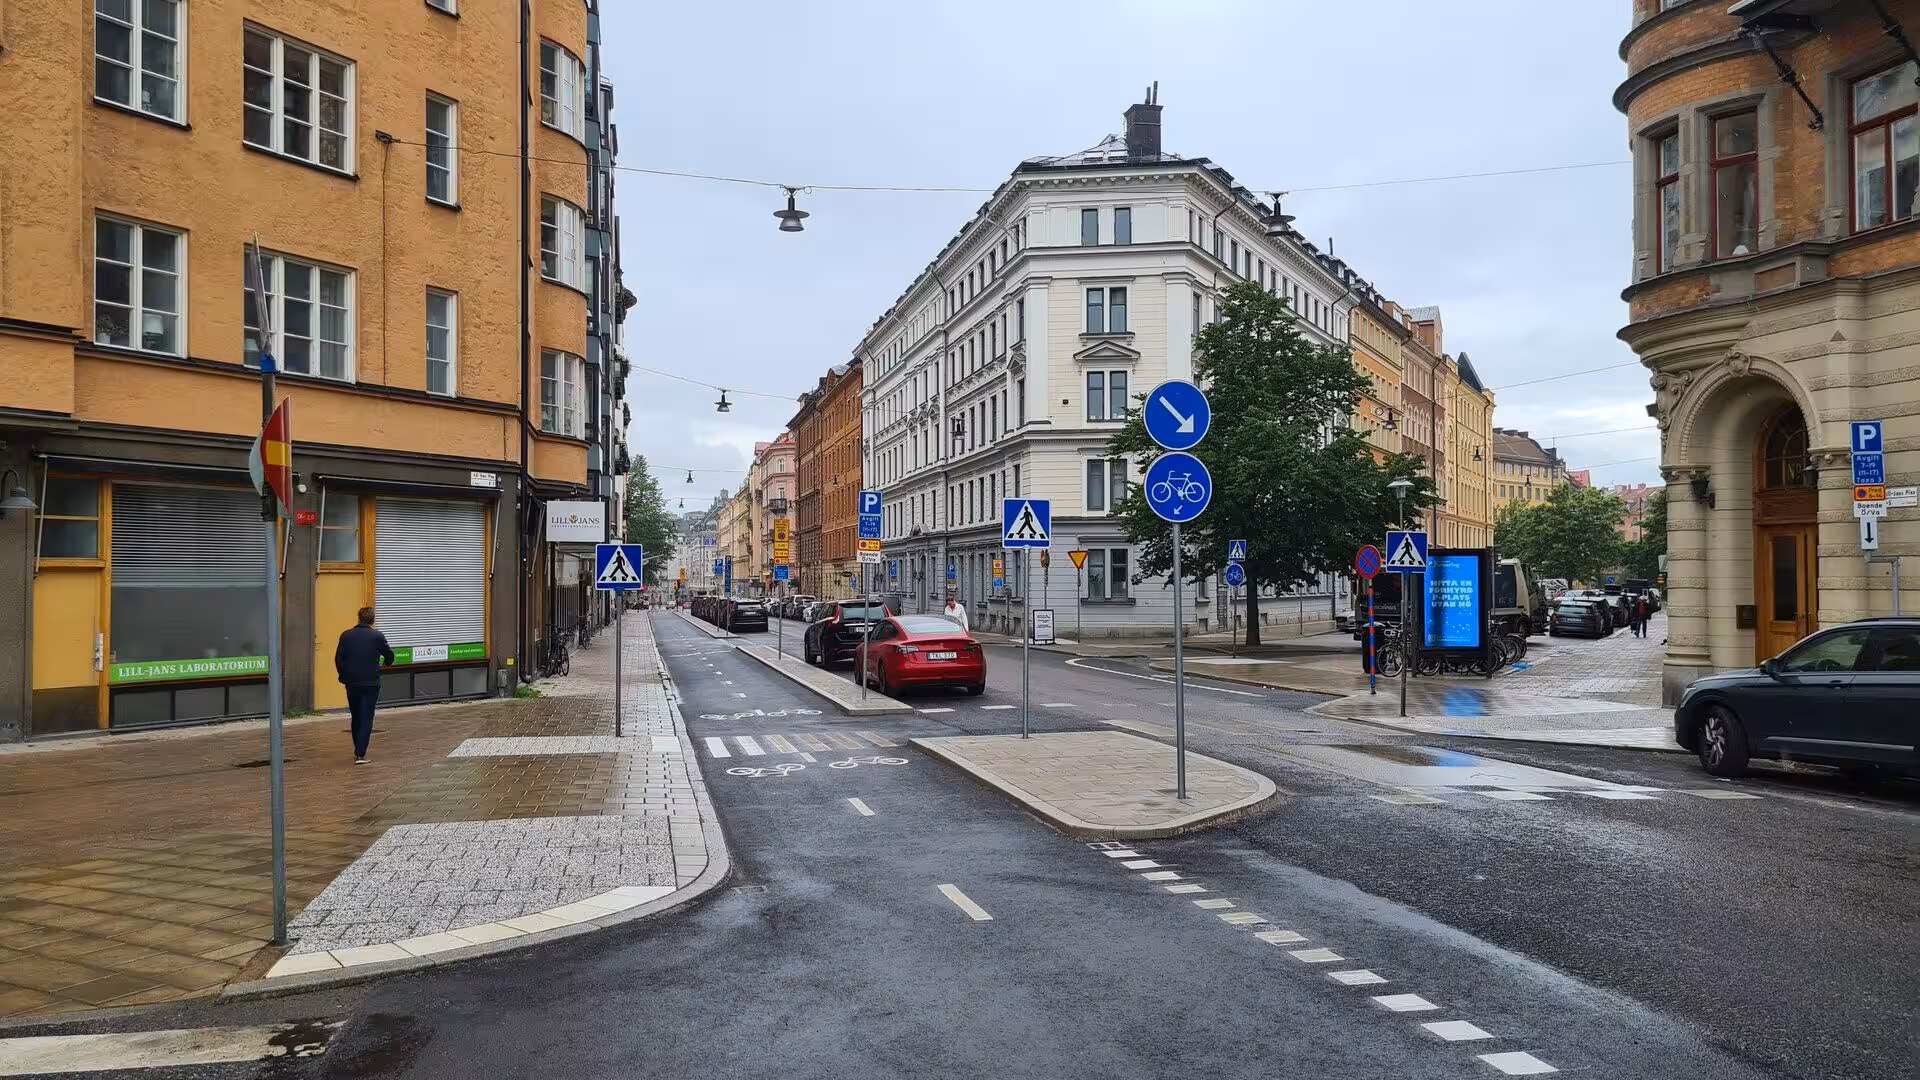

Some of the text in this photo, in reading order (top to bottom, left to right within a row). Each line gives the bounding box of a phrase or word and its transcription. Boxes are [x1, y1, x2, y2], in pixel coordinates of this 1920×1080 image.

[1859, 424, 1877, 450] P
[864, 493, 878, 513] P
[578, 517, 600, 525] JANS
[118, 659, 266, 678] LILL-JANS LABORATORIUM
